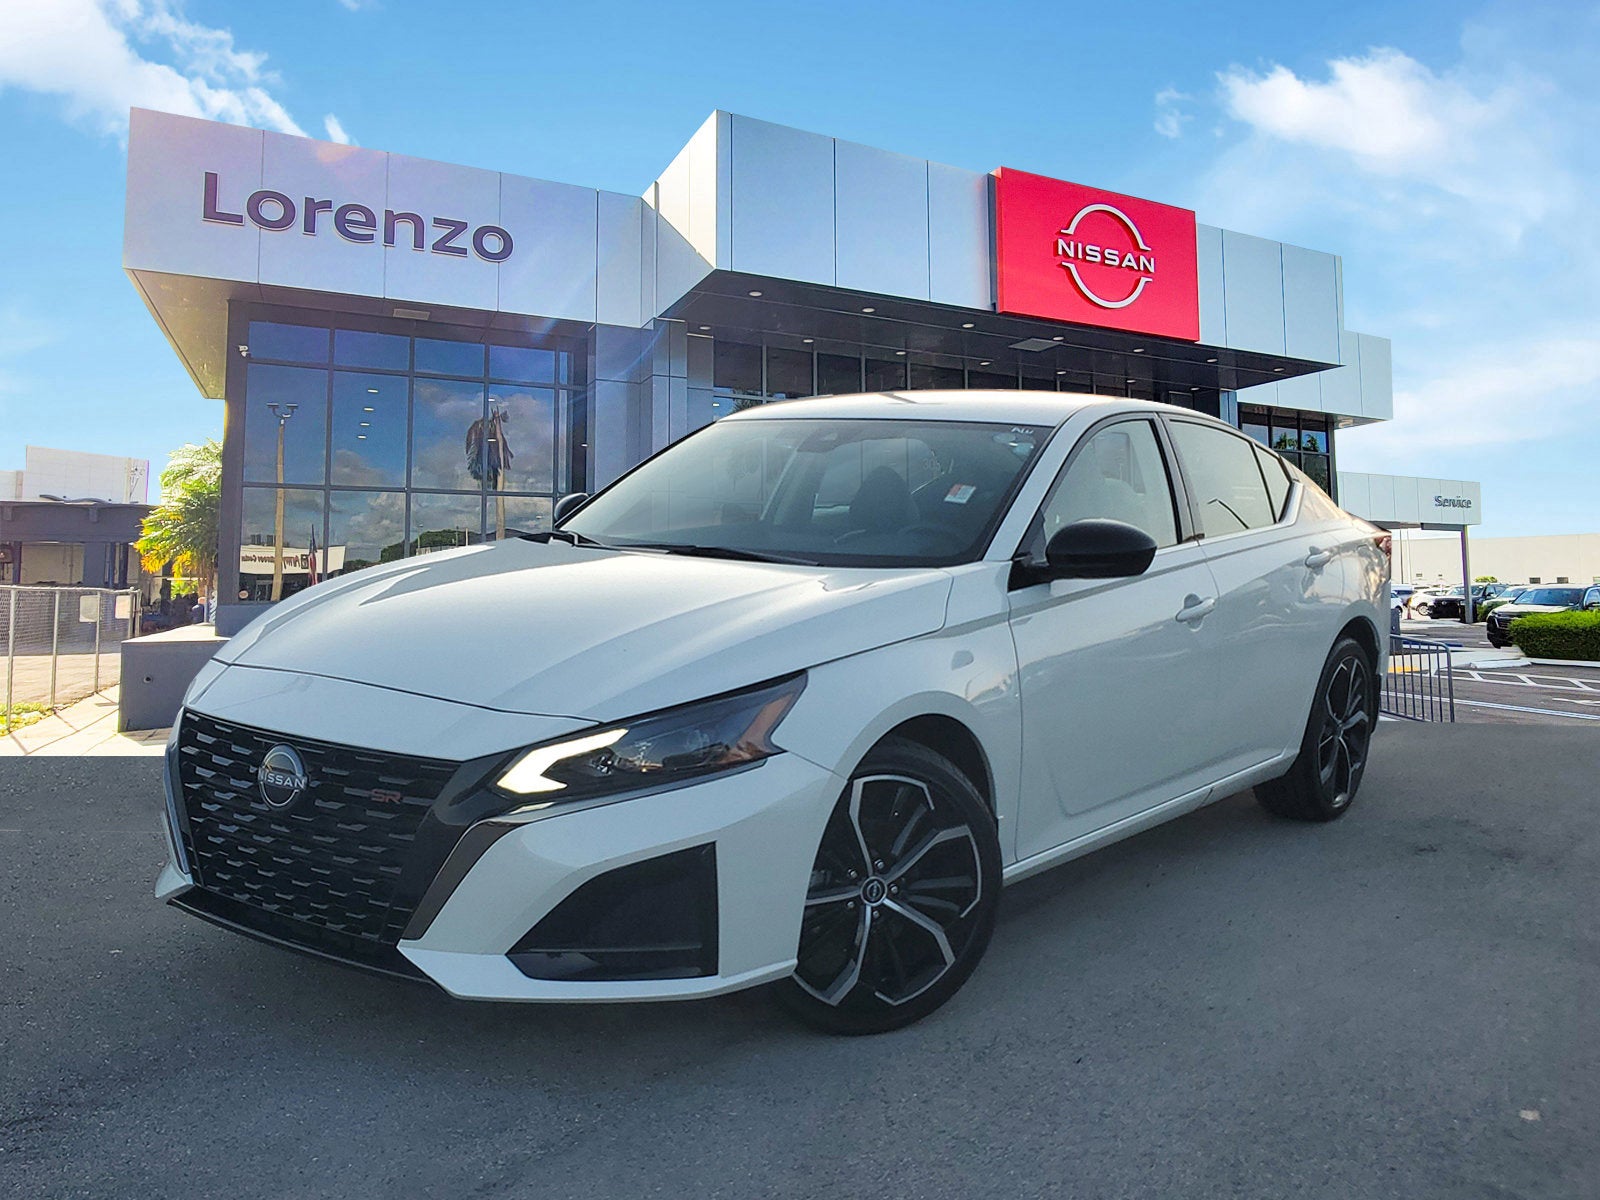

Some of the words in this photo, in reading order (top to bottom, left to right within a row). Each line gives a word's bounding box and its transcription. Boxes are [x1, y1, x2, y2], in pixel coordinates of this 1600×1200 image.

[202, 171, 514, 262] Lorenzo
[1057, 238, 1155, 273] NISSAN
[1434, 495, 1472, 508] Service
[259, 767, 306, 789] NISSAN
[371, 788, 401, 804] SR
